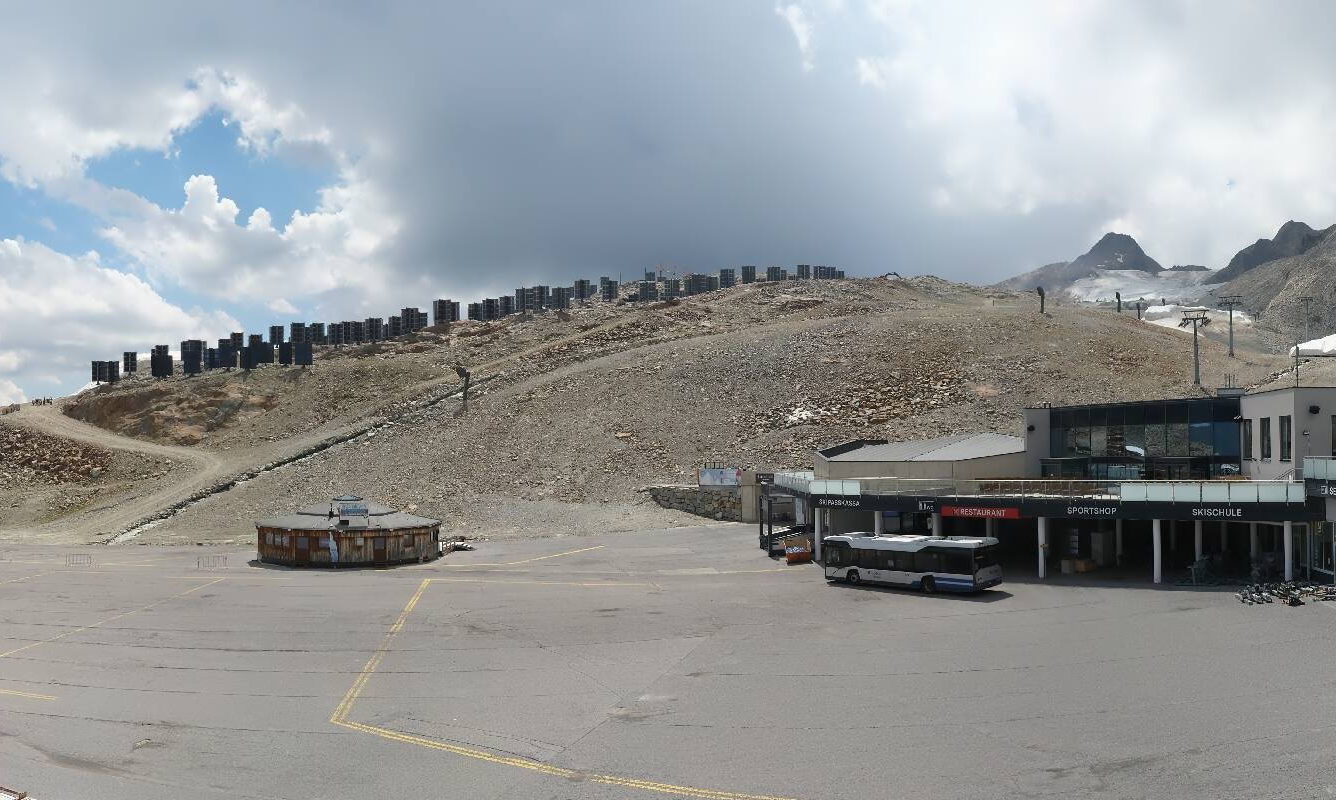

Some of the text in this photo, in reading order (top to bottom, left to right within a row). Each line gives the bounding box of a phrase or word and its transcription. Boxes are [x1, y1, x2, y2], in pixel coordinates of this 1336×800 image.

[960, 508, 1006, 517] RESTAURANT
[1067, 506, 1117, 515] SPORTSHOP
[1191, 508, 1242, 517] SKISCHULE
